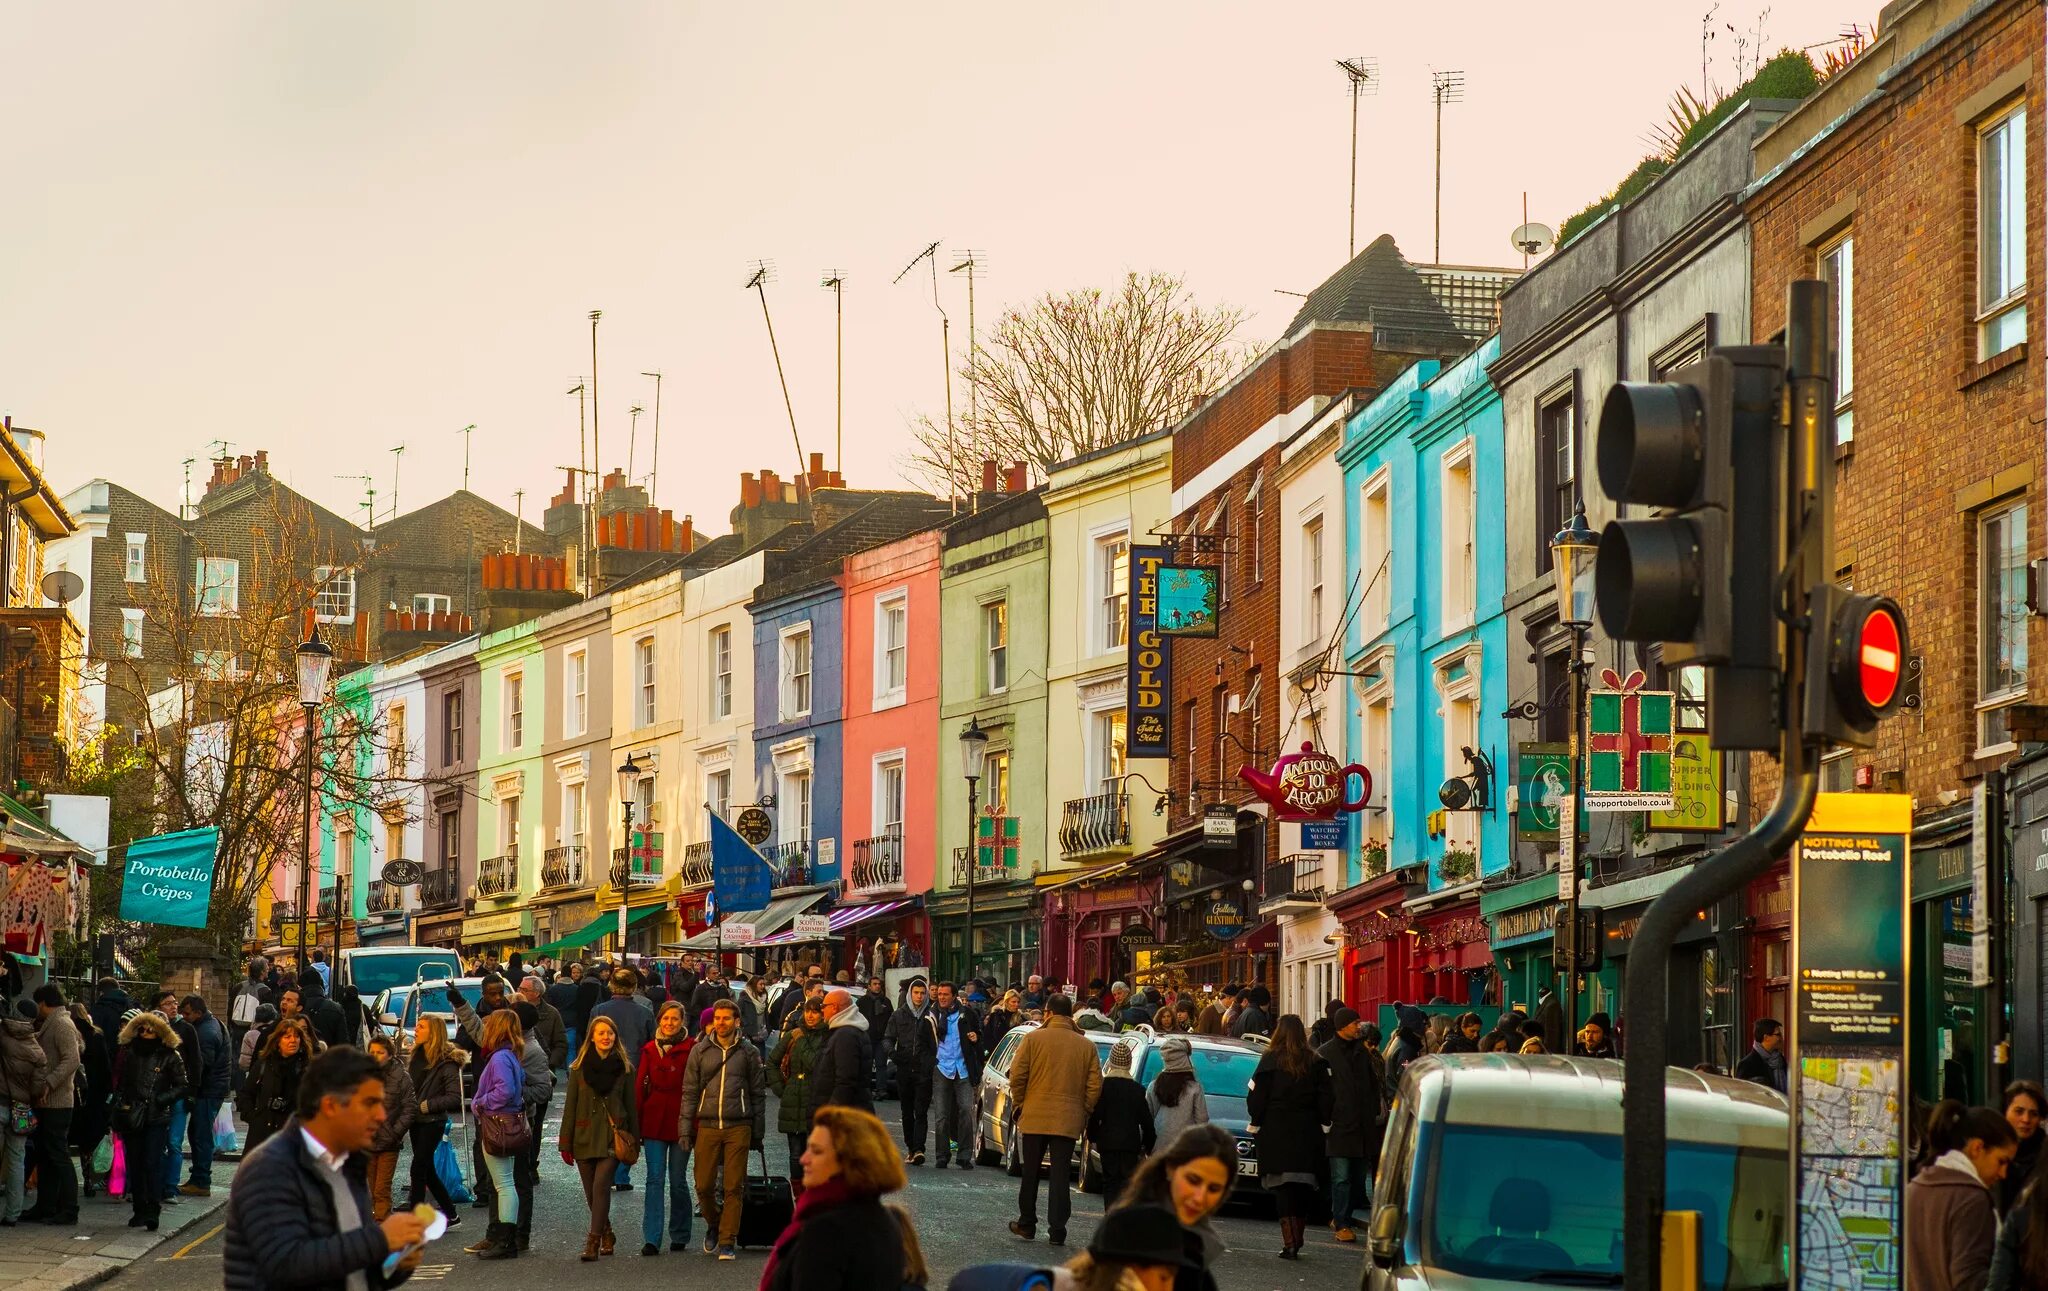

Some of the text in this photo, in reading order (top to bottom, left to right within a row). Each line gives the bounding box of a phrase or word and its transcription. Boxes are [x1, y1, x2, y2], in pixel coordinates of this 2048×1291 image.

[1137, 630, 1163, 709] GOLD
[1308, 774, 1326, 790] 101
[1284, 784, 1341, 808] ARCADE
[1587, 798, 1671, 808] shopportobello.co.uk
[1803, 838, 1880, 849] NOTTING HILL
[1803, 848, 1892, 861] Portobello Road
[129, 861, 209, 882] Portobello
[141, 882, 193, 901] Crêpes
[283, 926, 315, 941] Cae
[1121, 935, 1154, 944] OYSTER
